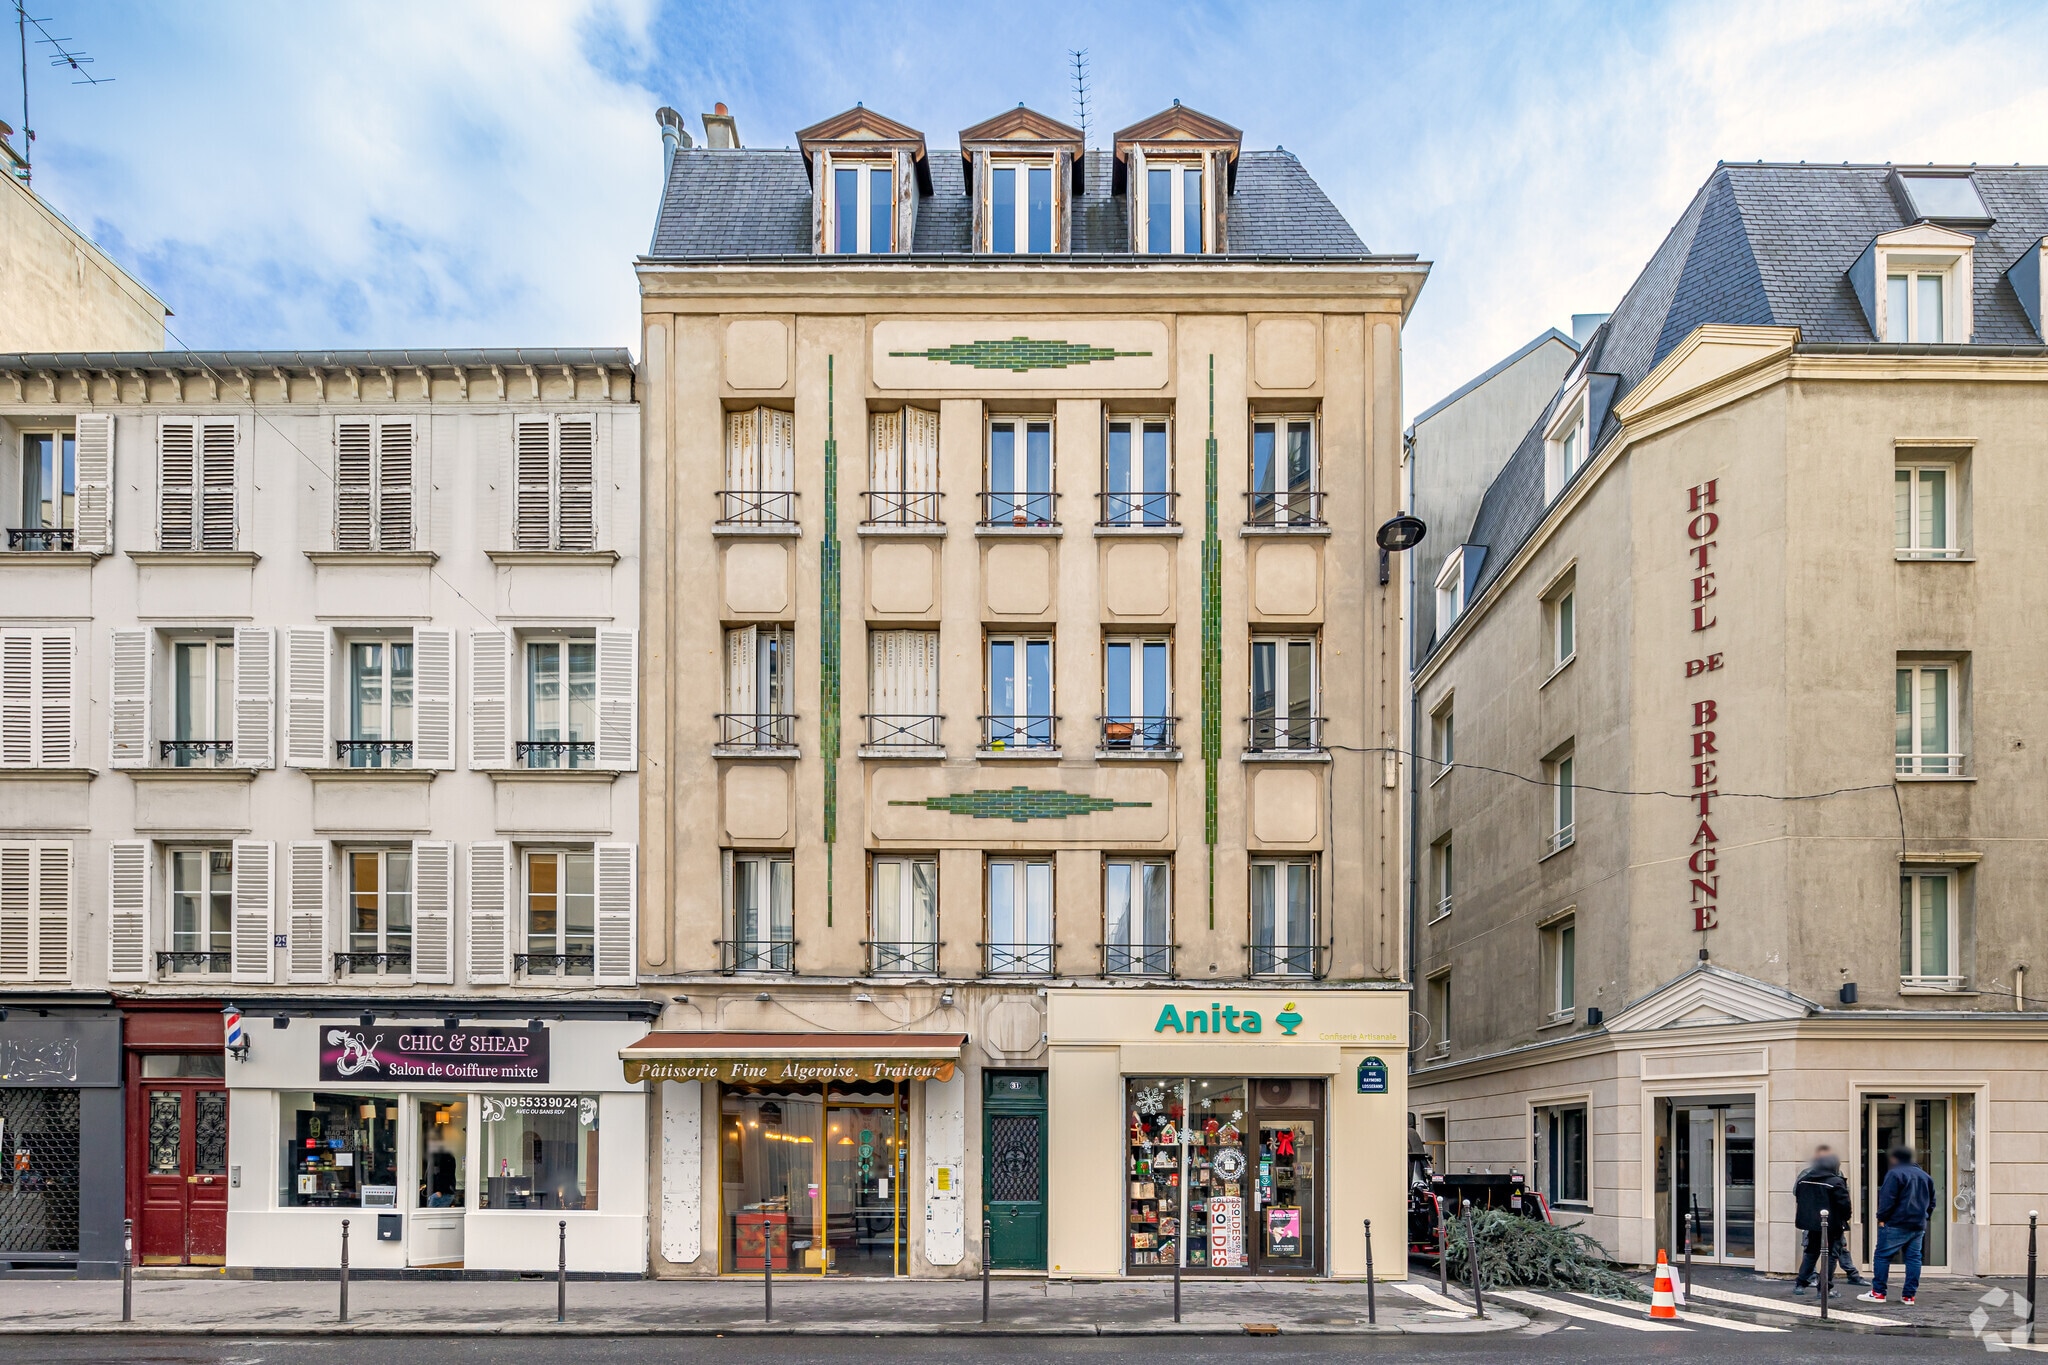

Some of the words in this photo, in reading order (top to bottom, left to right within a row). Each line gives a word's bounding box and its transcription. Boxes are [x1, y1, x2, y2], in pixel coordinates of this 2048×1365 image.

[1687, 477, 1719, 632] HOTEL
[1684, 652, 1724, 678] DE
[1688, 699, 1720, 932] BRETAGNE
[1154, 1002, 1262, 1033] Anita
[398, 1034, 443, 1051] CHIC
[449, 1034, 466, 1051] &
[470, 1035, 530, 1052] SHEAP
[1319, 1032, 1357, 1041] Confiserie
[1359, 1032, 1397, 1041] Artisanale
[389, 1063, 425, 1077] Salon
[427, 1062, 442, 1077] de
[445, 1062, 498, 1077] Coiffure
[501, 1064, 538, 1078] mixte
[638, 1061, 718, 1077] Pâtisserie
[731, 1063, 768, 1077] Fine
[781, 1063, 859, 1081] Algeroise.
[874, 1063, 940, 1077] Traiteur
[504, 1097, 518, 1107] 09
[519, 1097, 533, 1107] 55
[533, 1097, 547, 1107] 33
[549, 1097, 562, 1107] 90
[564, 1097, 578, 1108] 24
[1211, 1203, 1228, 1267] SOLDES
[1231, 1203, 1241, 1242] SOLDES
